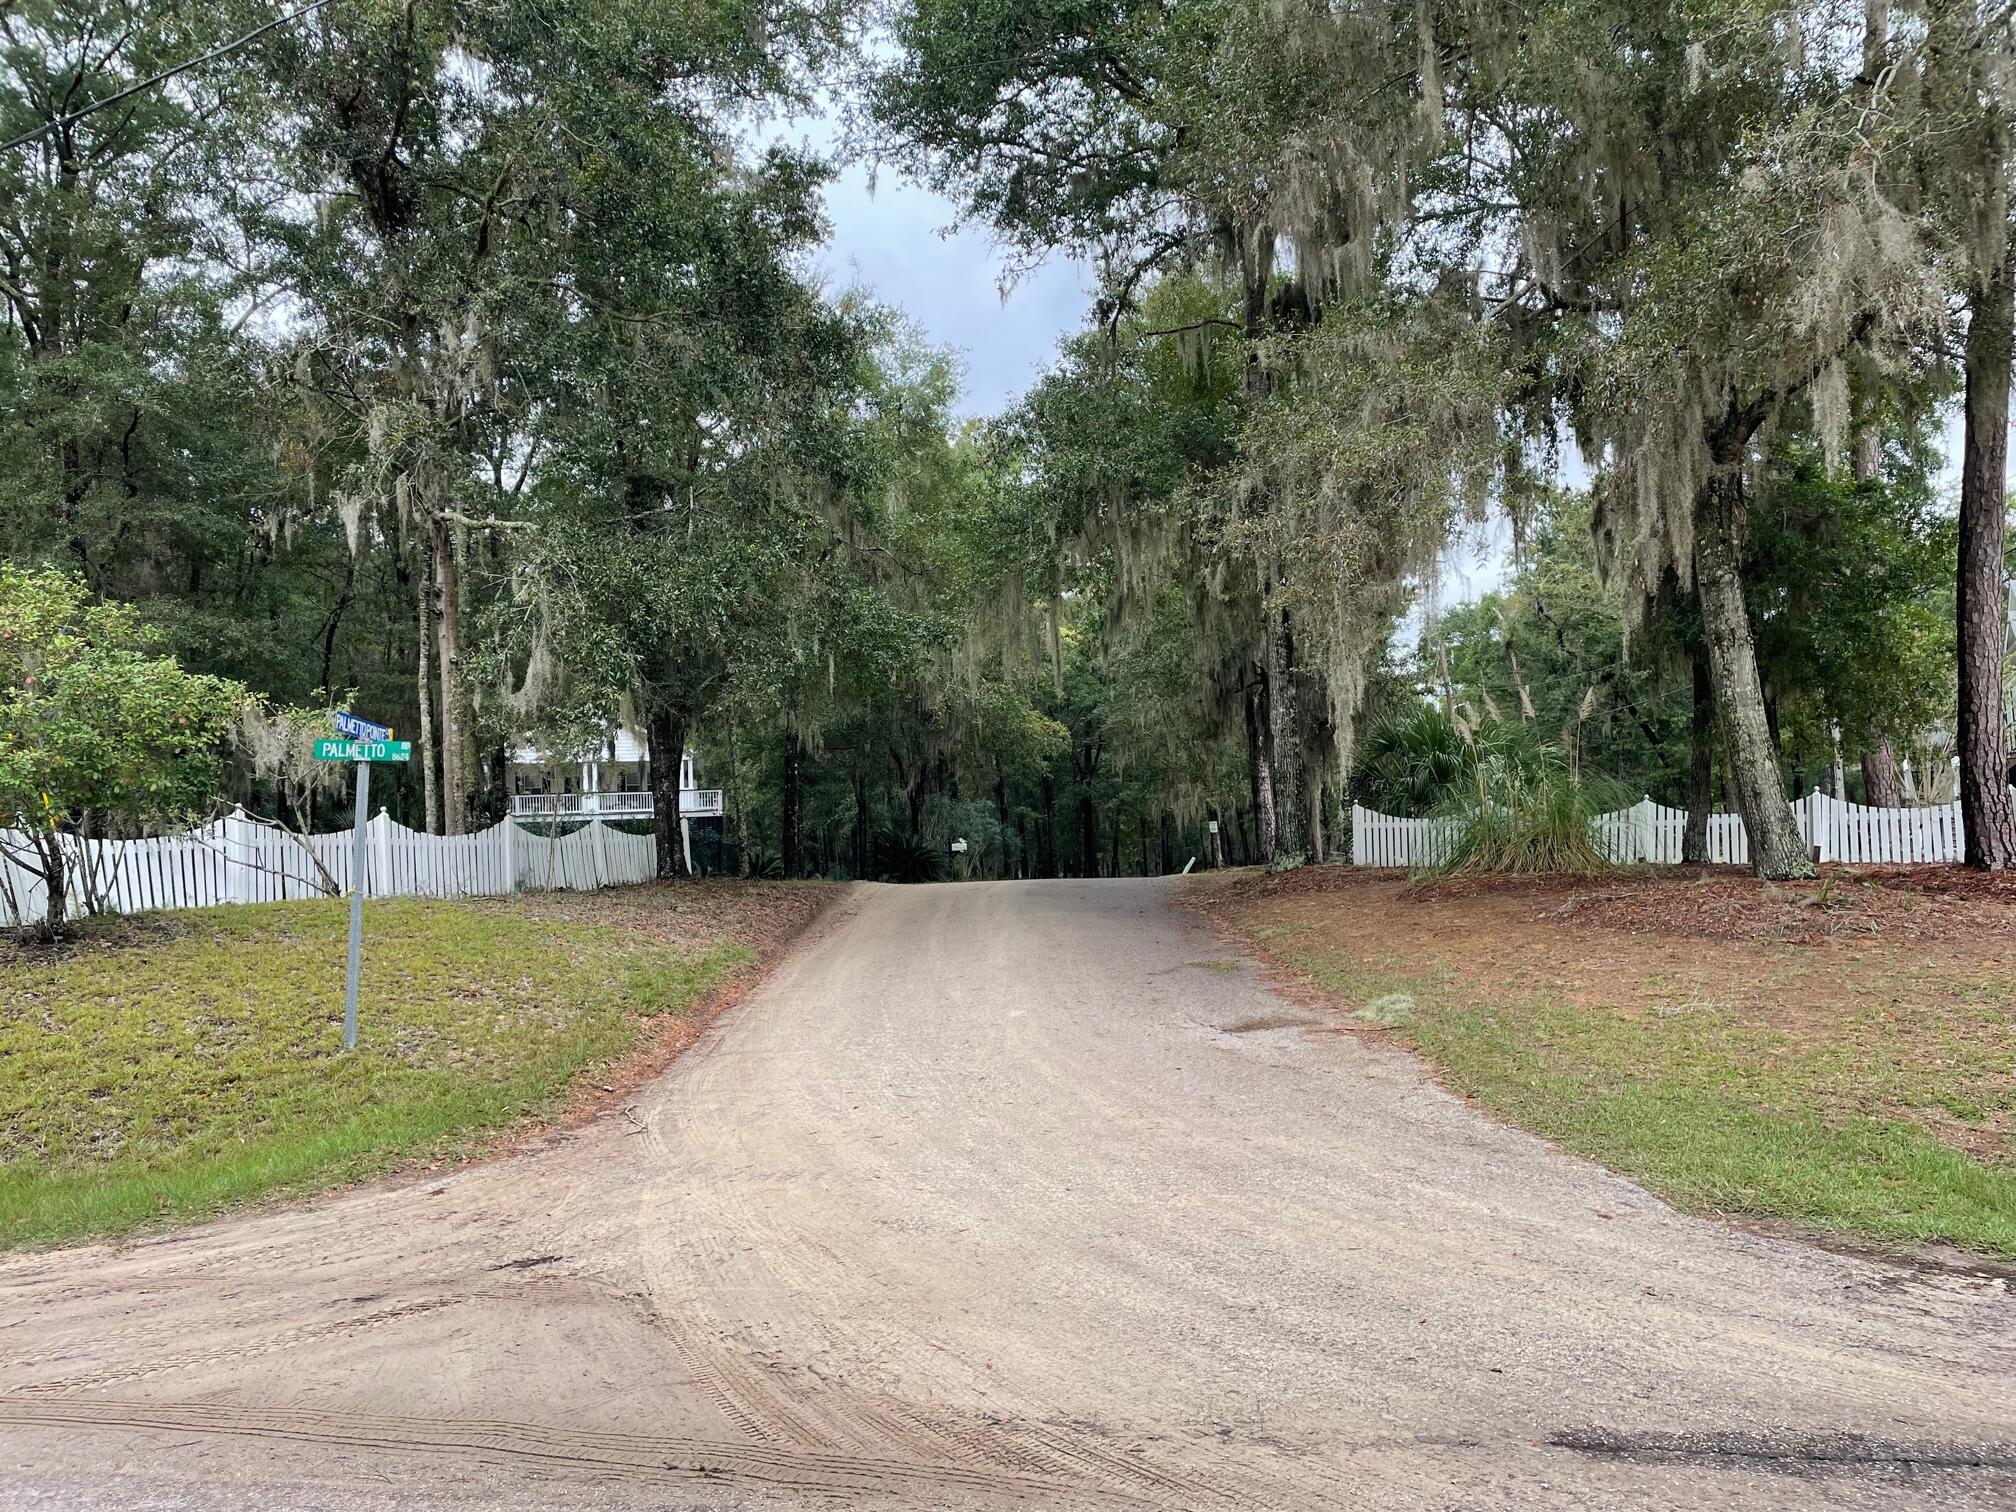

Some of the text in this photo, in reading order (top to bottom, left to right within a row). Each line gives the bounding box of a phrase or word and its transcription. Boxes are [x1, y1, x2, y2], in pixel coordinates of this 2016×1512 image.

[336, 713, 366, 737] PALMETTO
[322, 742, 411, 758] PALMETTO RD
